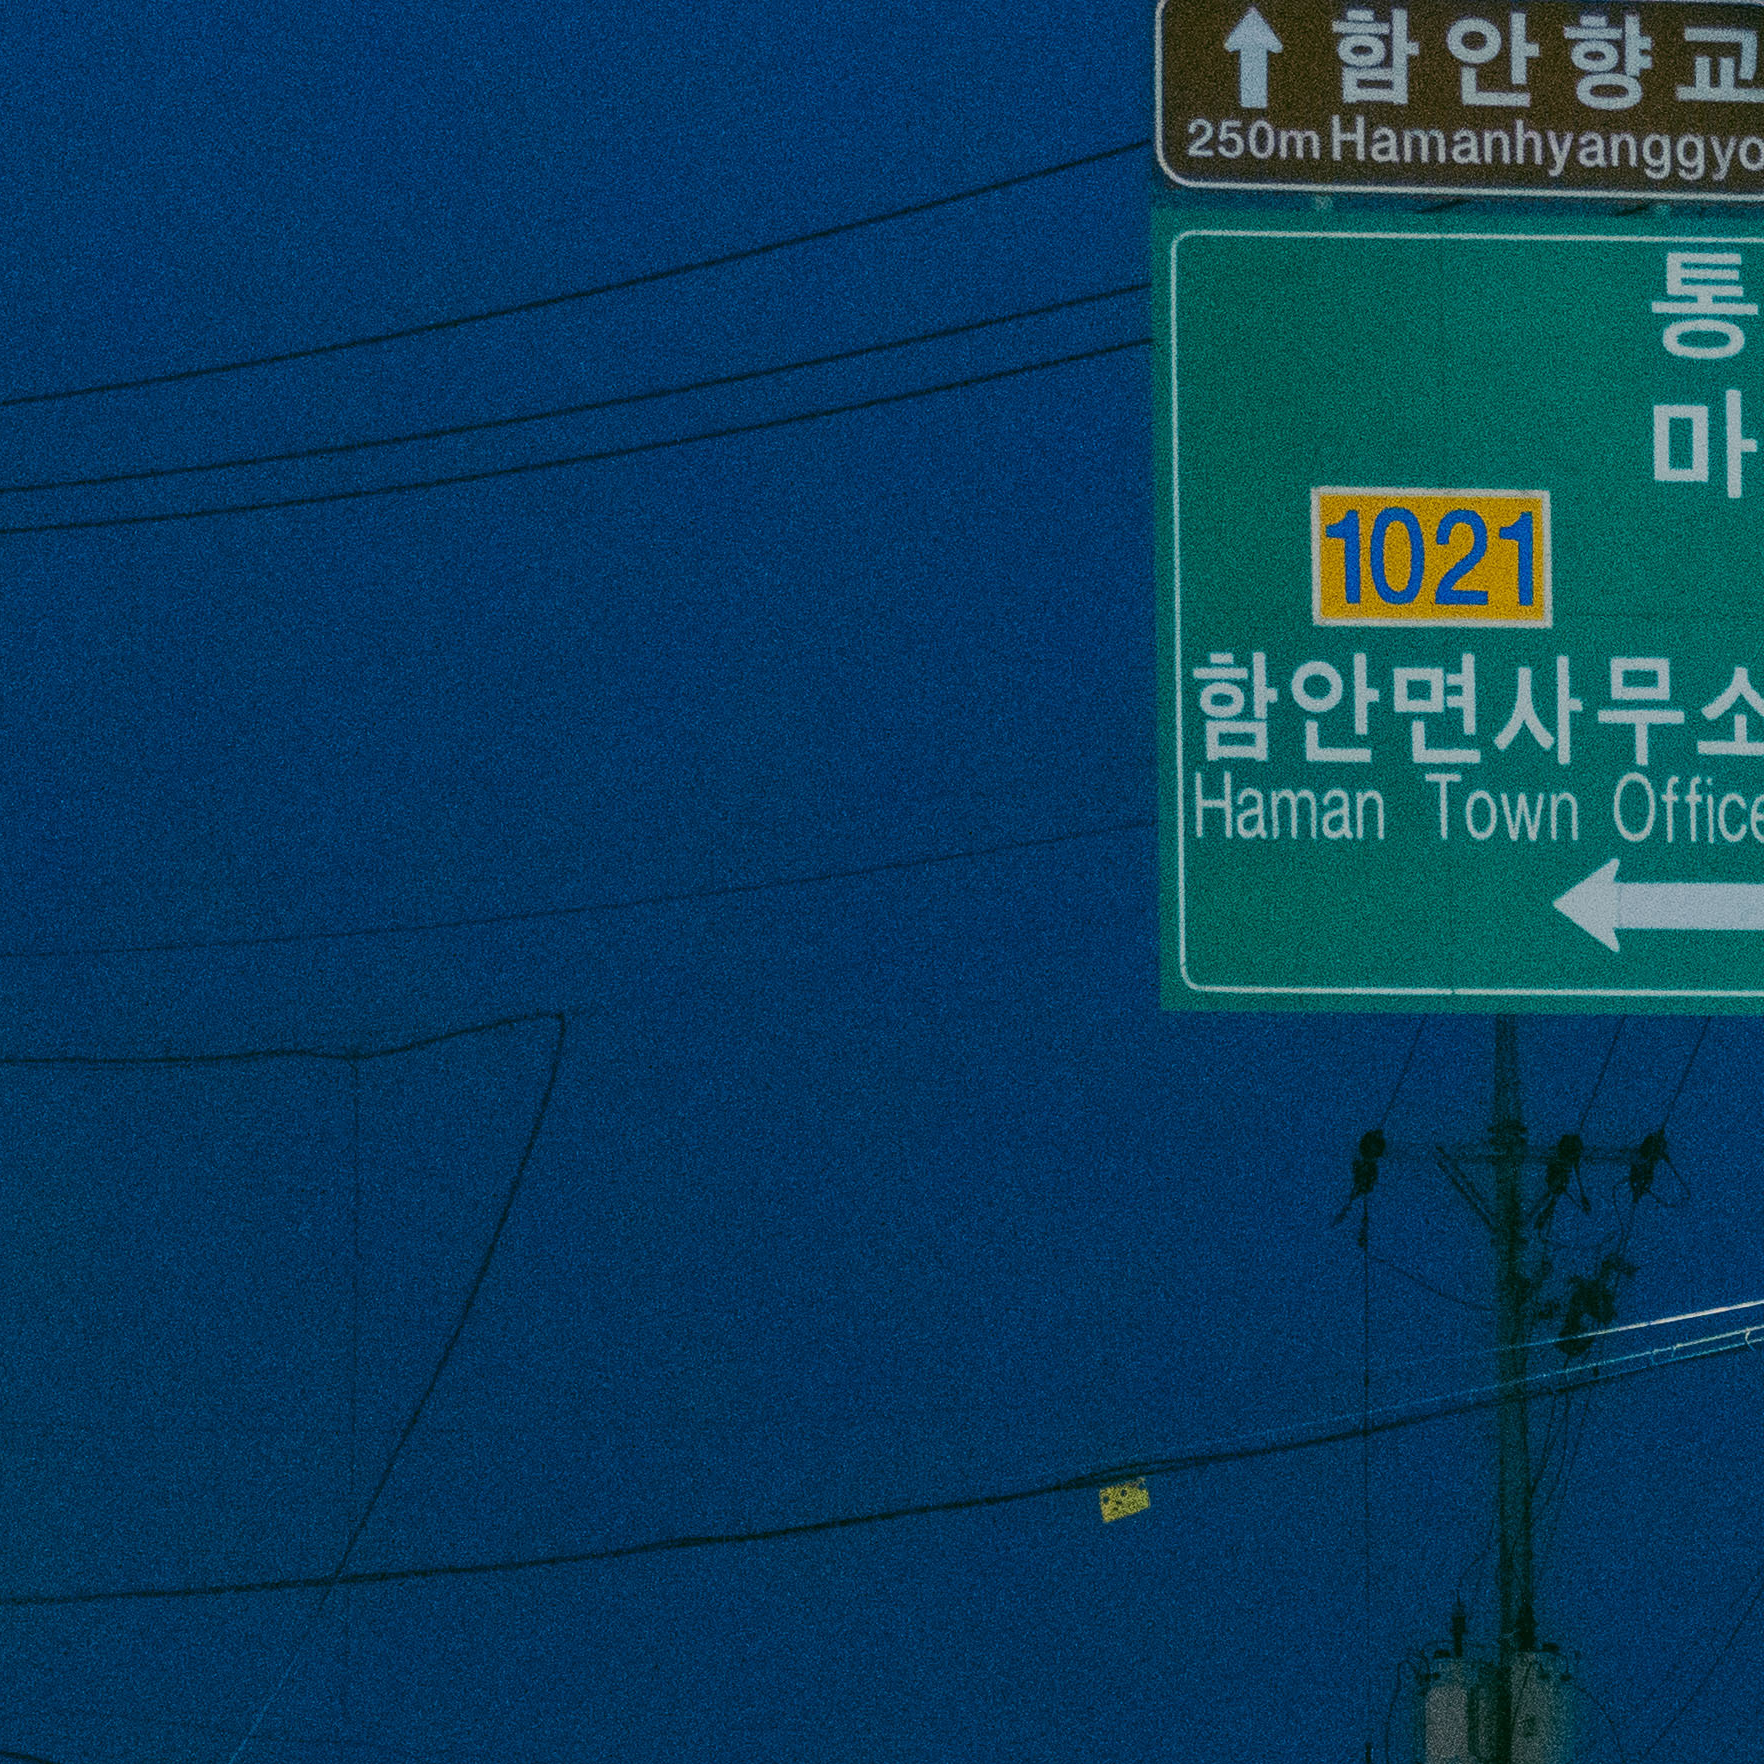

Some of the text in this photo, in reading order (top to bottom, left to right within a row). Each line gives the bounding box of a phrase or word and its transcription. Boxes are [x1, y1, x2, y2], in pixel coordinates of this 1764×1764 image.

[1187, 118, 1321, 160] 250m
[1325, 506, 1535, 606] 1021
[1193, 771, 1385, 841] Haman
[1425, 773, 1579, 843] Town
